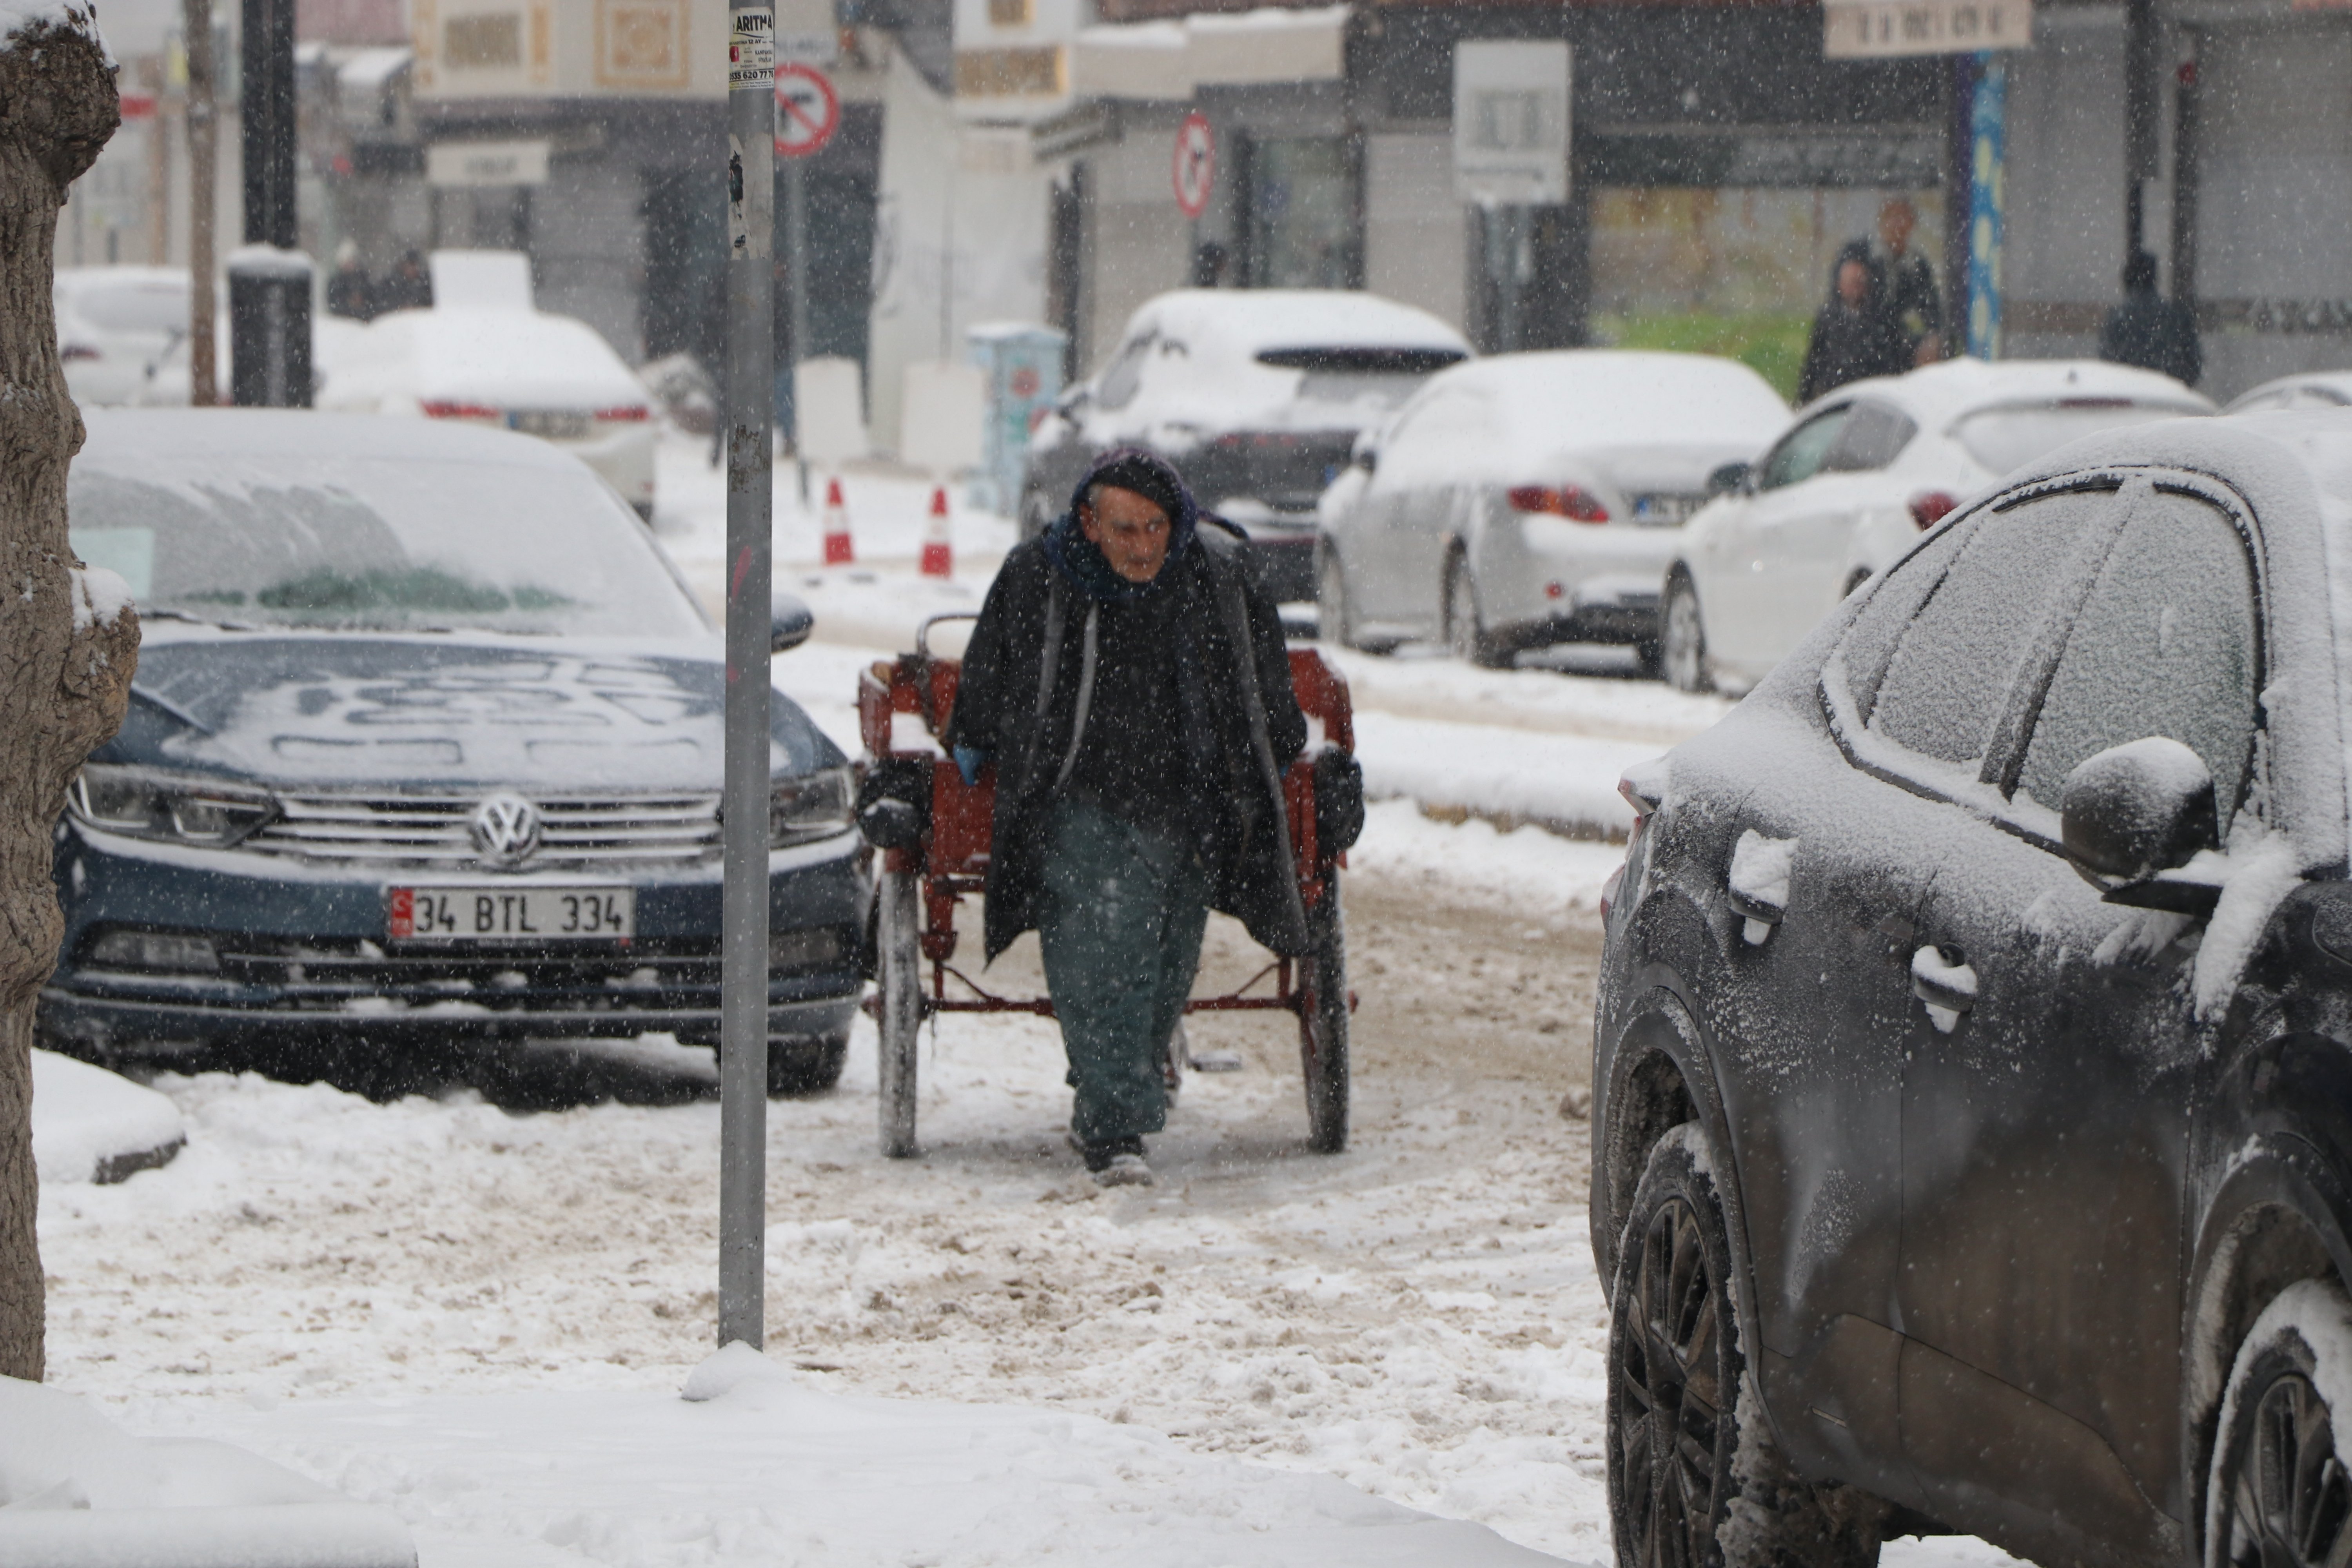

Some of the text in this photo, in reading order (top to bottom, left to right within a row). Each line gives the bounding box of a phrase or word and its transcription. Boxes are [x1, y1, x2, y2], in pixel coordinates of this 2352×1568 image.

[743, 71, 757, 79] 620
[416, 895, 622, 932] 34 BTL 334
